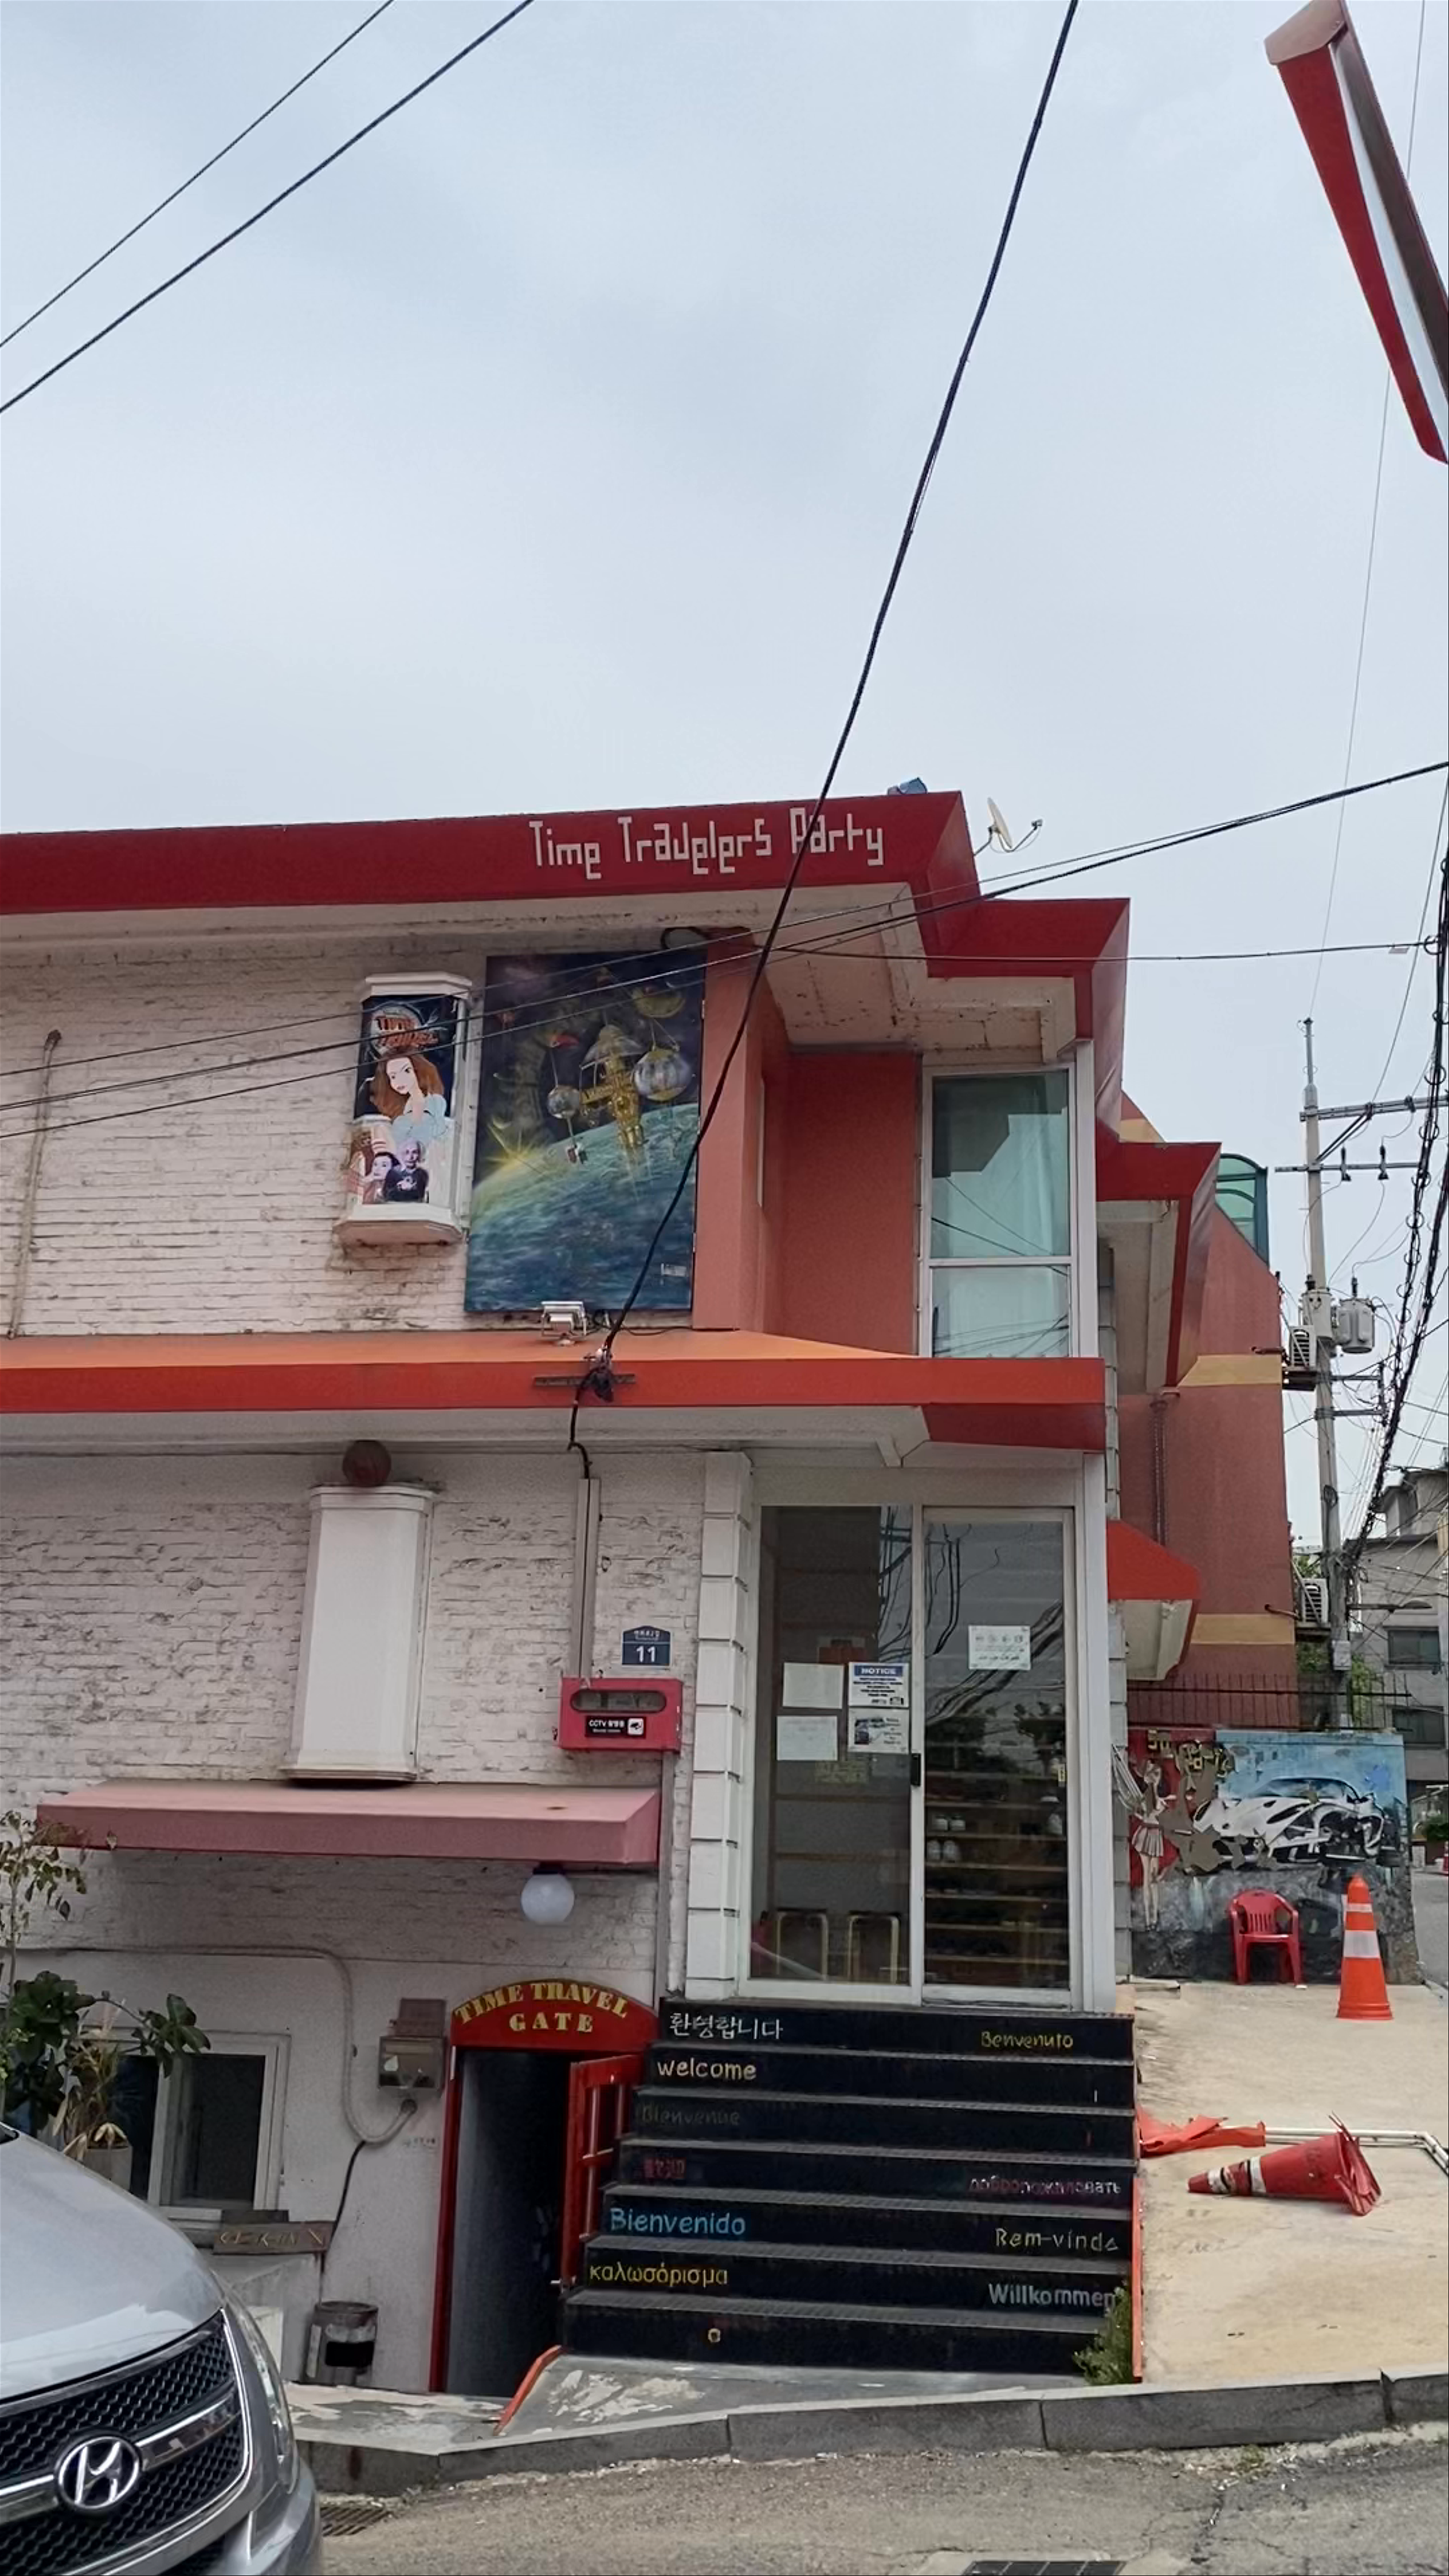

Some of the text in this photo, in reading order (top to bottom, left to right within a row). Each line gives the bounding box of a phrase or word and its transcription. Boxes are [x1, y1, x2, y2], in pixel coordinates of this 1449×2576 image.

[529, 807, 883, 880] Time Travelers Party
[636, 1646, 655, 1662] 11
[455, 1982, 628, 2025] TIME TRAVEL
[509, 2012, 593, 2033] GATE
[981, 2031, 1074, 2049] Benvenuto
[657, 2058, 757, 2080] welcome
[610, 2207, 746, 2236] Bienvenido
[988, 2283, 1115, 2308] Willkommen
